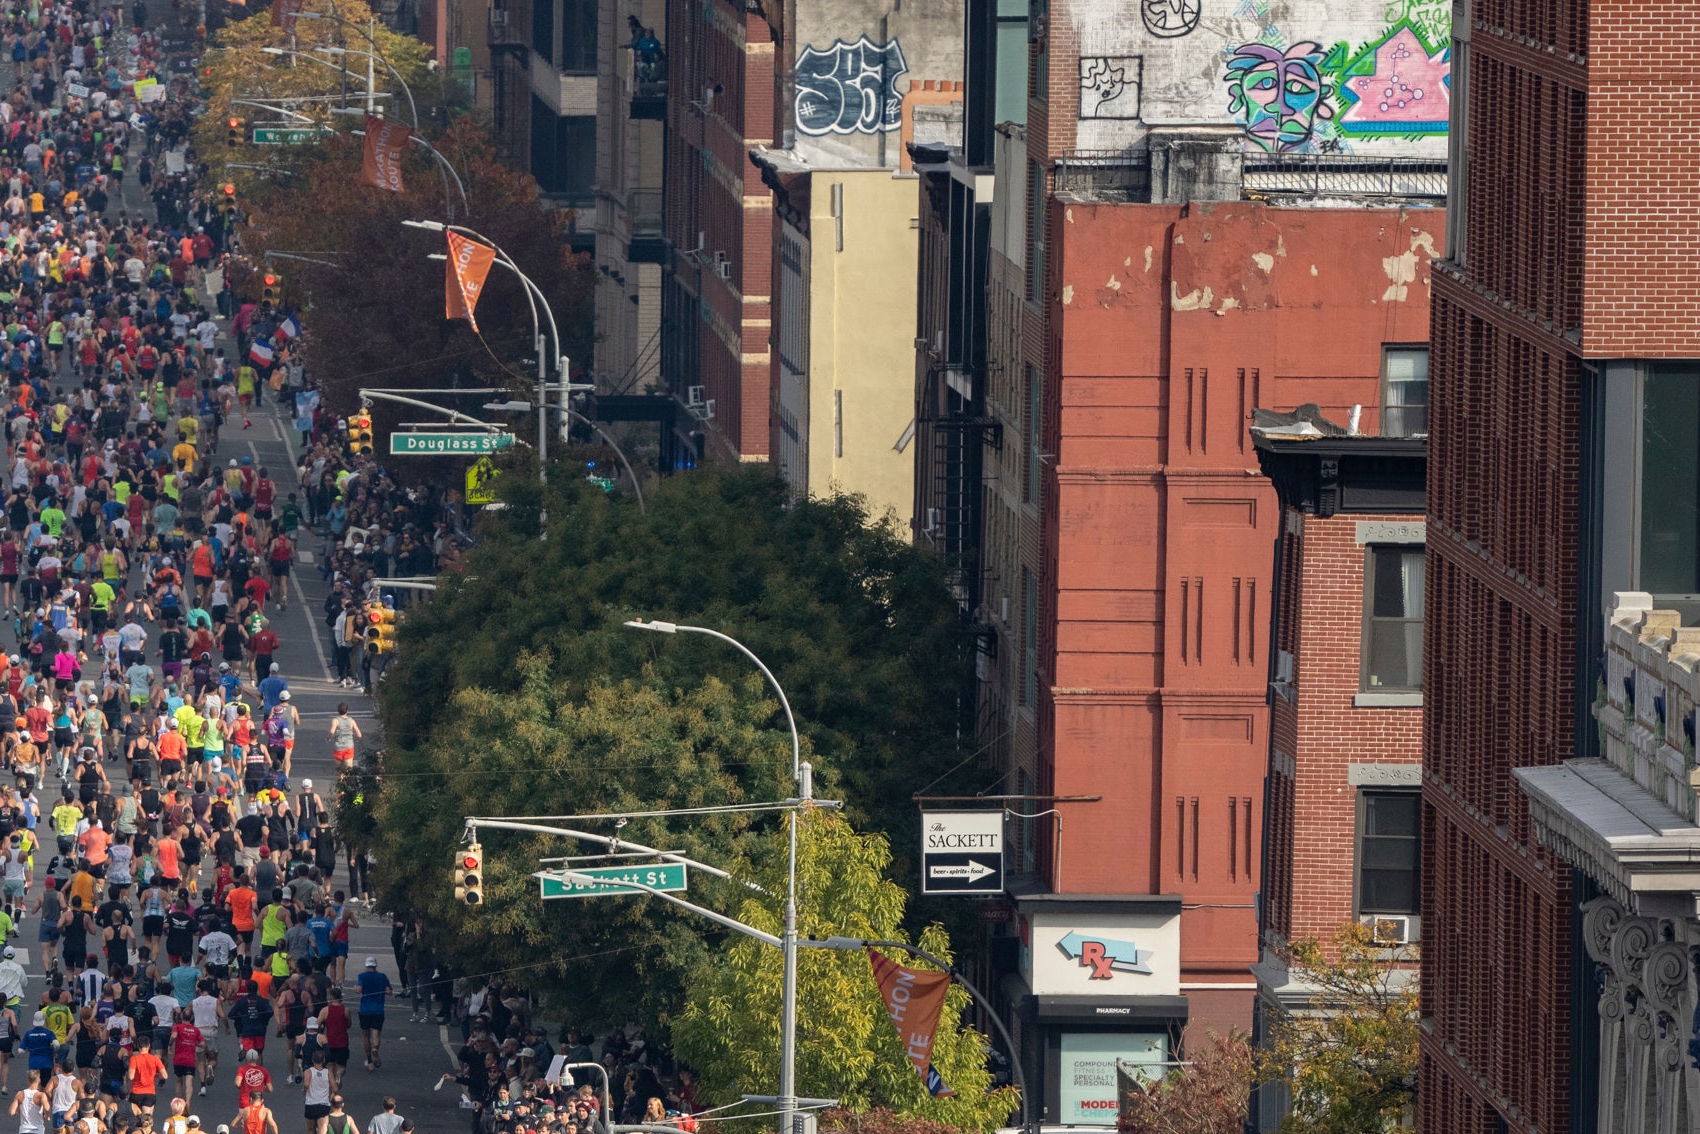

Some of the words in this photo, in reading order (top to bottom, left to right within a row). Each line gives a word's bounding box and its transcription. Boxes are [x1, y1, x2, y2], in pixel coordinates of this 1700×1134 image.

[404, 437, 475, 452] Douglass
[478, 437, 495, 450] St
[929, 822, 948, 832] The
[928, 833, 999, 849] SACKETT
[647, 870, 668, 886] St
